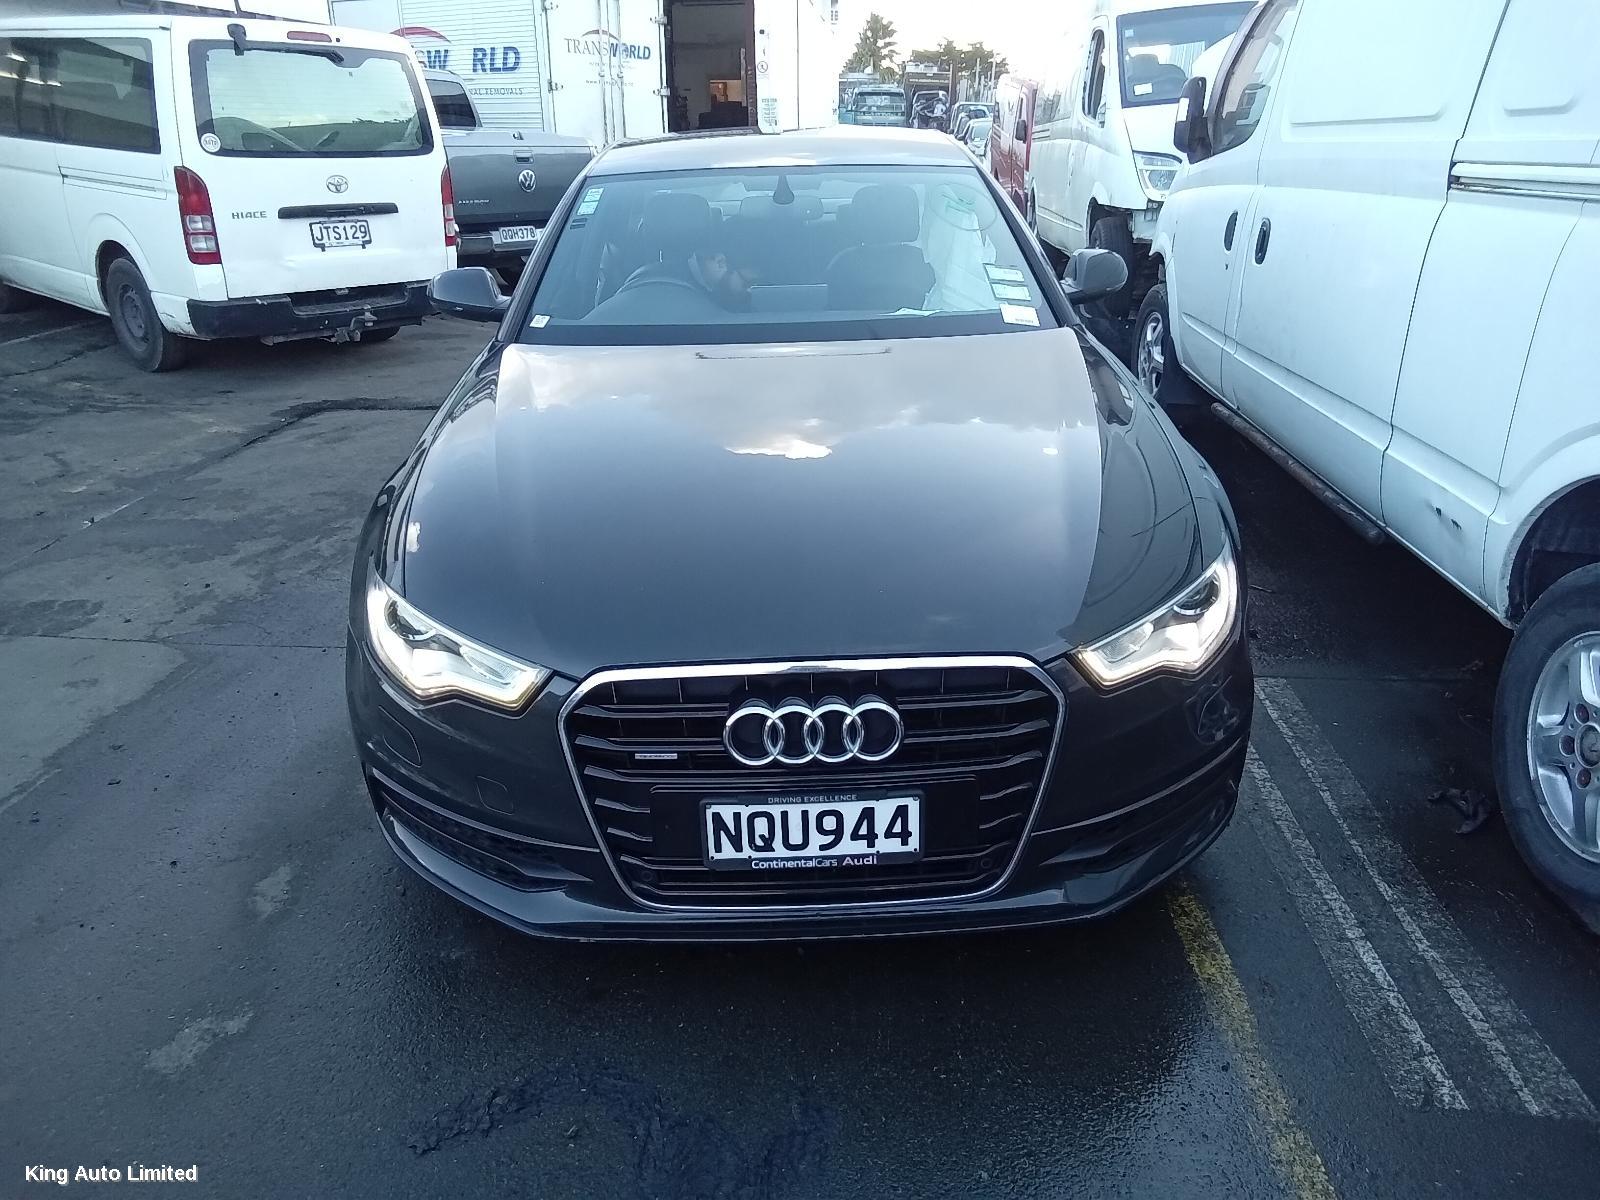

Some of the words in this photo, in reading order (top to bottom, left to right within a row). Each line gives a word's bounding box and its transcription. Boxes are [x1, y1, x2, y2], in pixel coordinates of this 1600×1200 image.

[485, 87, 523, 96] REMOVALS
[231, 210, 268, 220] HIACE
[315, 224, 369, 242] JTS129
[501, 229, 536, 241] QQH378
[767, 796, 802, 804] DRIVING
[804, 794, 858, 802] EXCELLENCE
[711, 804, 913, 854] NQU944
[842, 855, 878, 866] Audi
